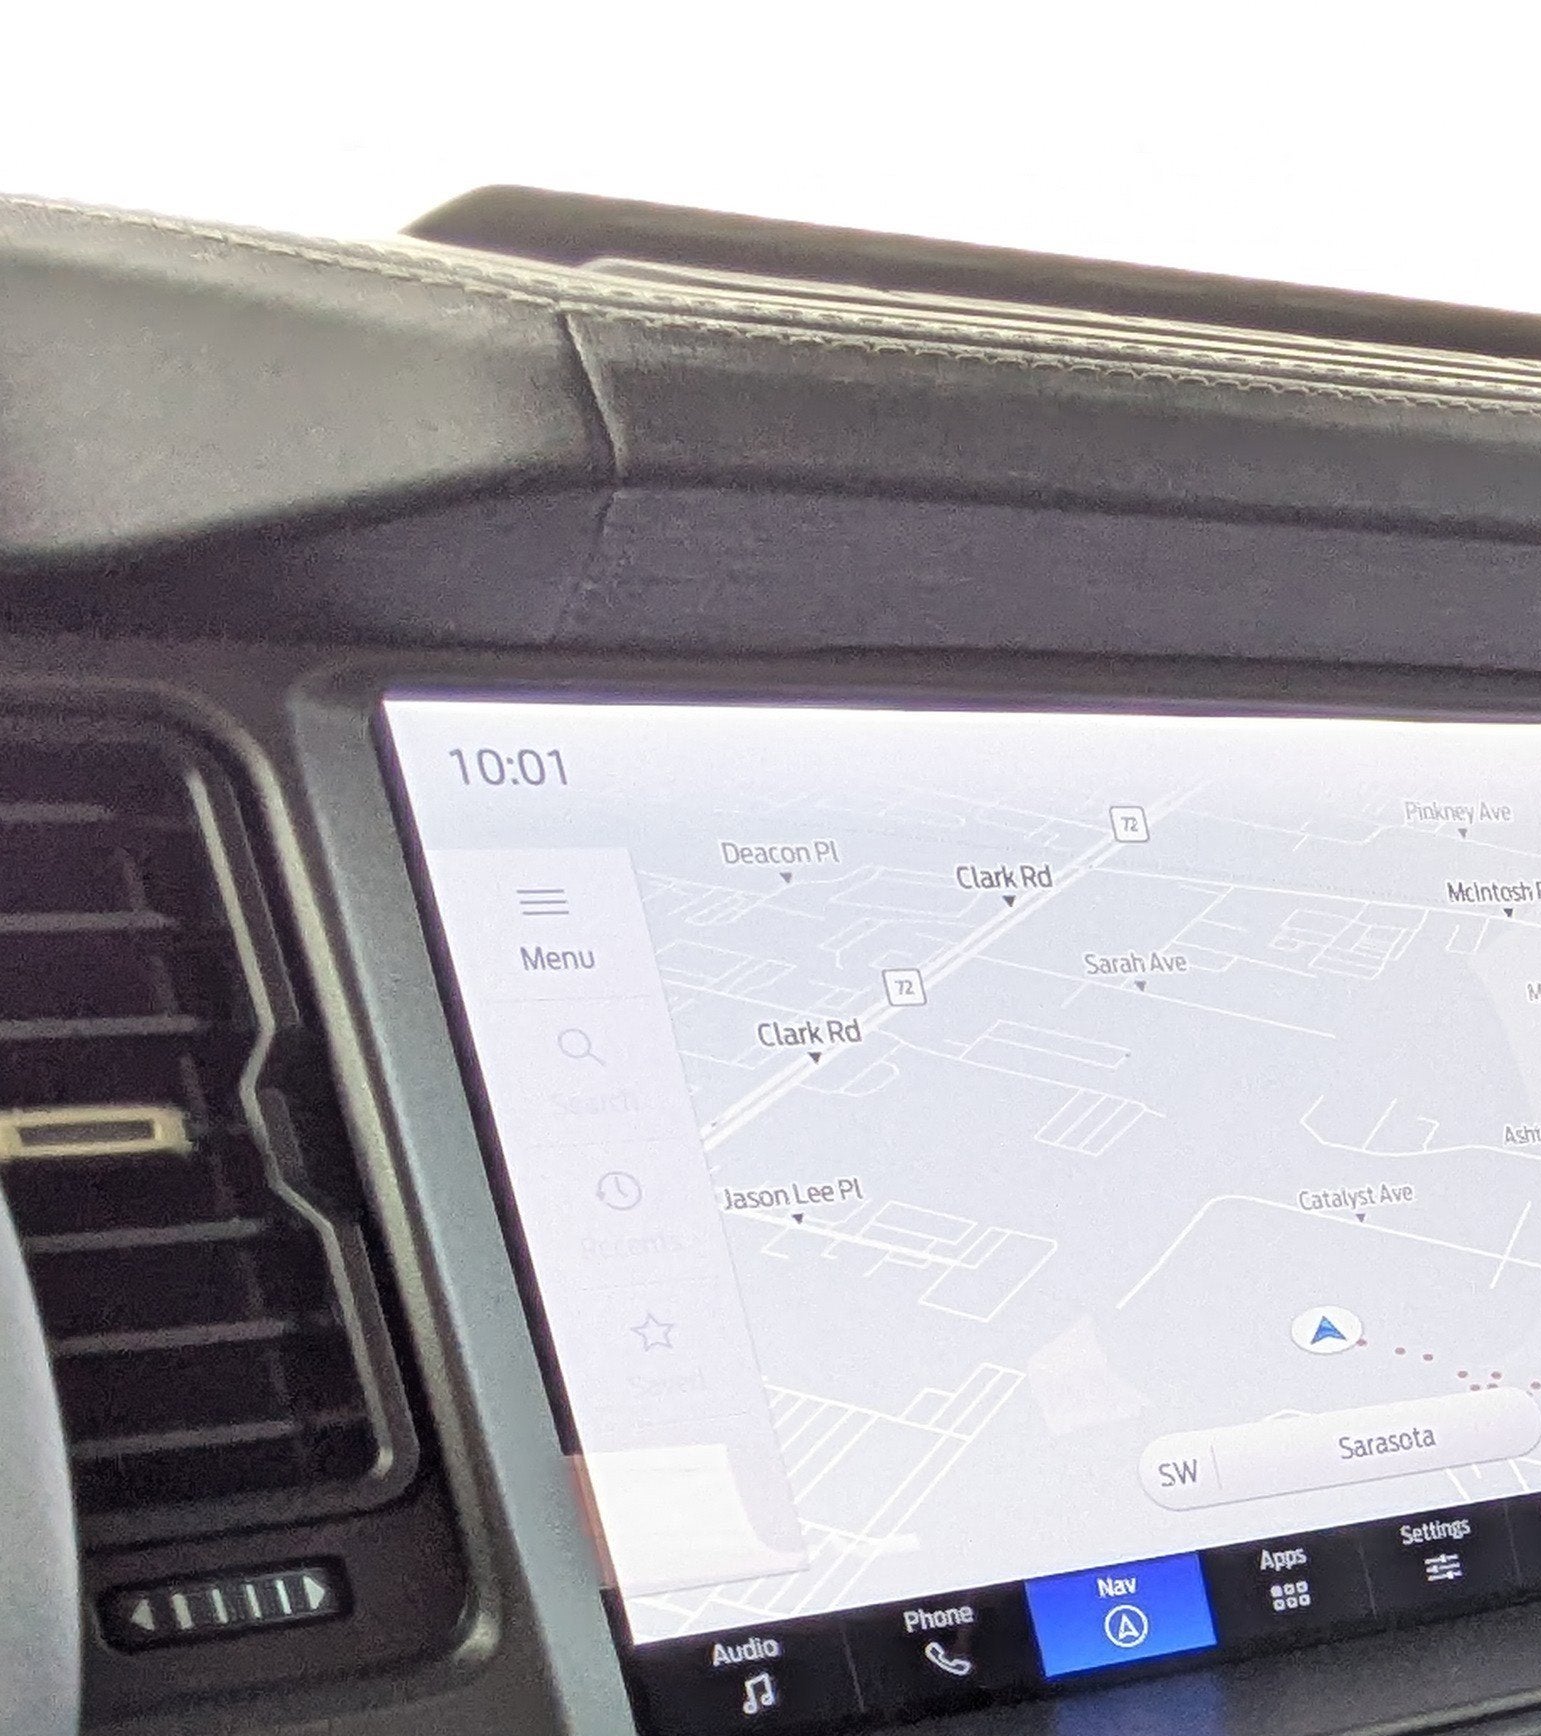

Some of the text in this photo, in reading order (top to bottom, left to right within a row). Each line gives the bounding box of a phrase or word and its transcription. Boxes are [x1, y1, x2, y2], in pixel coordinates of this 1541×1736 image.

[449, 747, 568, 786] 10:01
[1405, 802, 1512, 824] Pinkney Ave
[721, 840, 840, 866] Deacon Pl
[956, 865, 1052, 889] Clark Rd
[1447, 882, 1533, 902] McIntosh
[521, 947, 595, 971] Menu
[1085, 954, 1187, 975] Sarah Ave
[895, 978, 913, 996] 72
[757, 1019, 861, 1046] Clark Rd
[725, 1178, 863, 1211] Jason Lee Pl
[1299, 1183, 1414, 1211] Catalyst Ave
[1158, 1427, 1437, 1487] SW Sarasota
[1401, 1516, 1471, 1546] Settings
[1260, 1547, 1307, 1572] Apps
[1097, 1575, 1136, 1599] Nav
[903, 1603, 974, 1633] Phone
[712, 1635, 780, 1667] Audio
